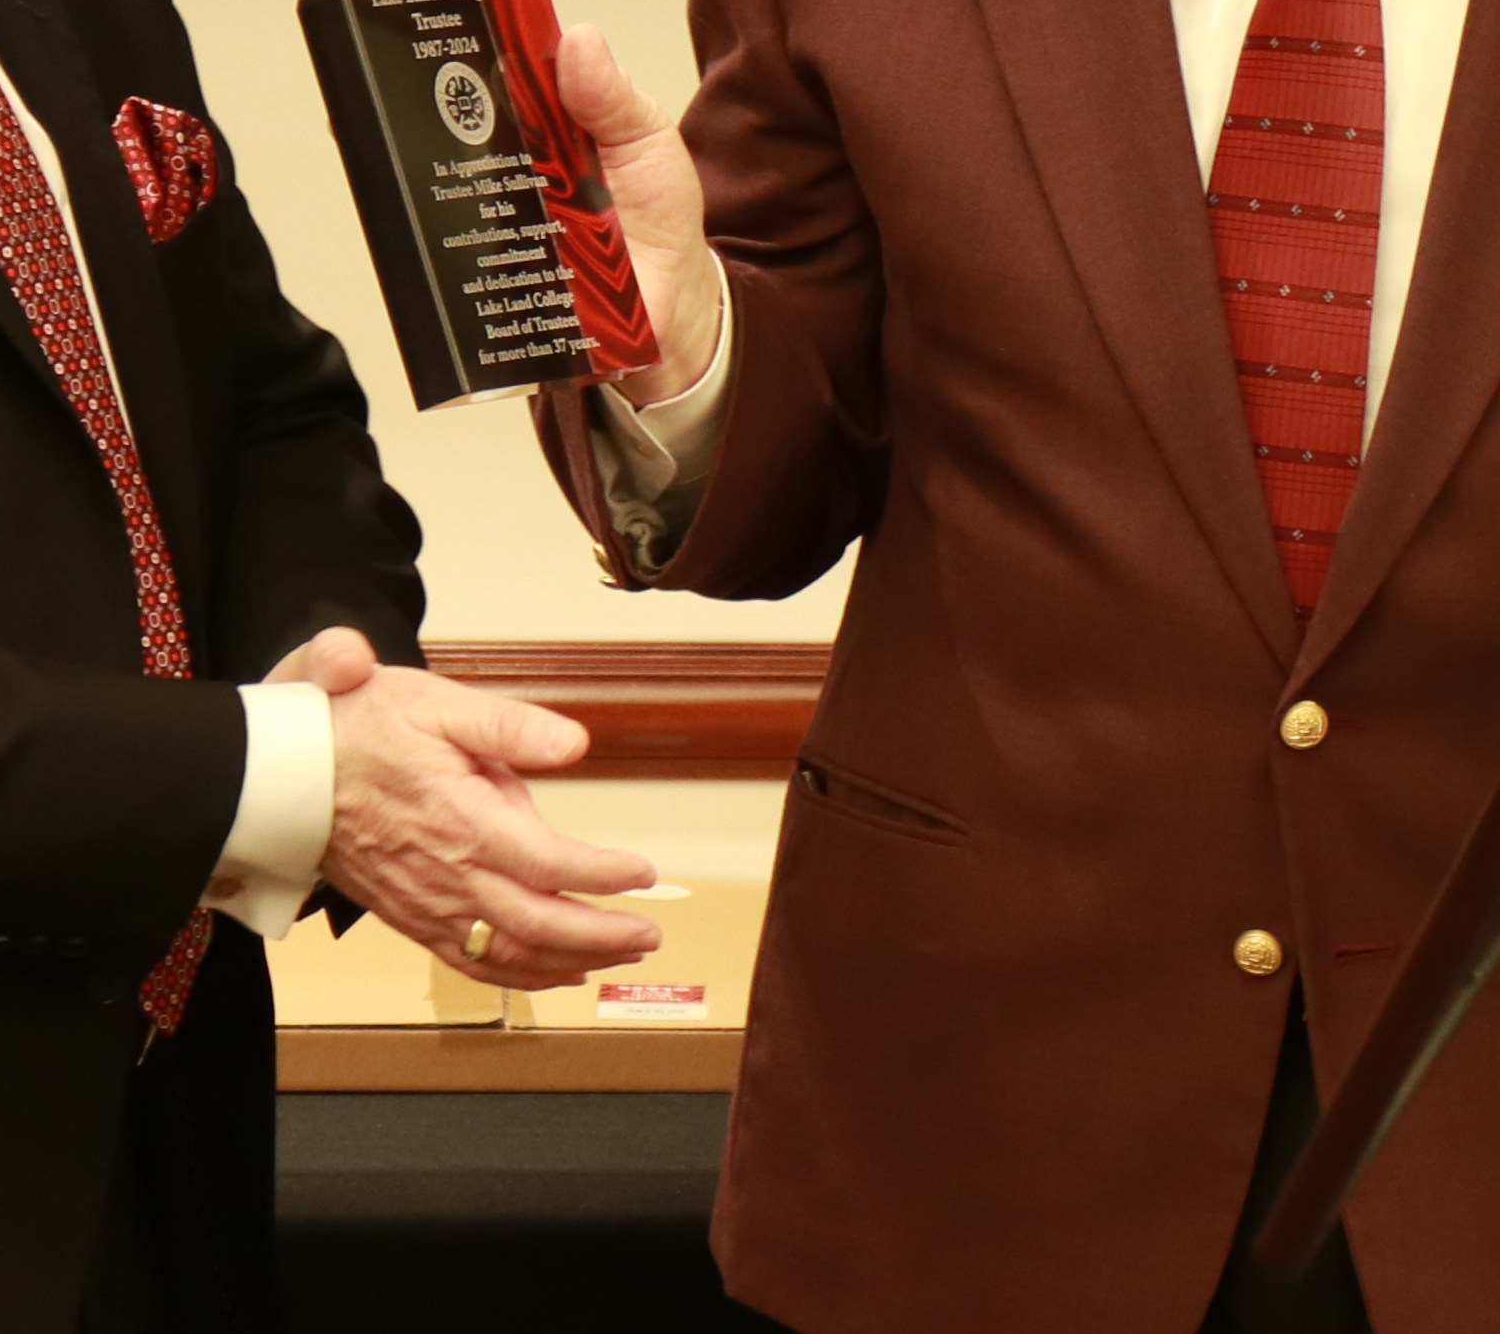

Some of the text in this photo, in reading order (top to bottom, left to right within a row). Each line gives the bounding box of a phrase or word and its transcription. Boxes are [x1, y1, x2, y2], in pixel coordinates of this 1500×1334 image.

[411, 12, 463, 31] Trustee
[411, 36, 480, 60] 1987-2024
[432, 152, 532, 178] In Appreciation to
[430, 174, 549, 201] Trustee Mike Sullivan
[478, 200, 516, 219] for his
[443, 220, 567, 248] contributions, support,
[476, 246, 548, 268] commitment
[462, 264, 575, 294] and dedication to the
[475, 290, 575, 317] Lake Land College
[485, 315, 581, 340] Board of Trustees
[478, 337, 601, 365] for more than 37 years.
